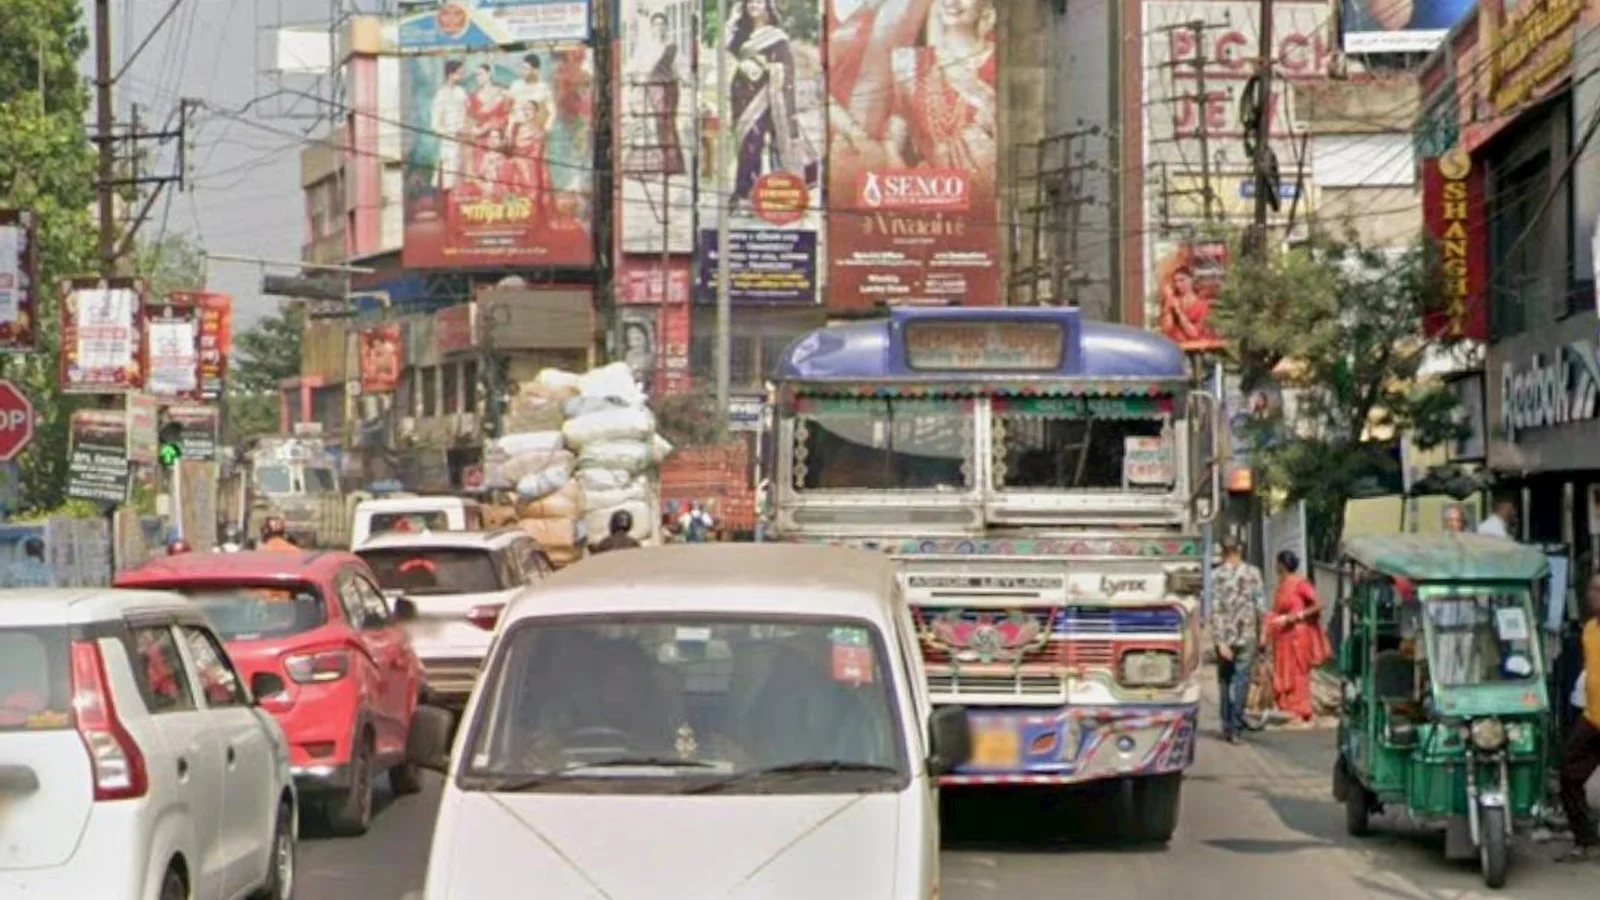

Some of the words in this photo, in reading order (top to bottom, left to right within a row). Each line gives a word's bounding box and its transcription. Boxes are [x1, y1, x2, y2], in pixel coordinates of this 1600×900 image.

[884, 174, 964, 197] SENCO
[1441, 182, 1468, 336] SHANGHAI
[1500, 346, 1570, 443] Reebok
[0, 410, 26, 431] OP
[1100, 575, 1146, 598] Lynx
